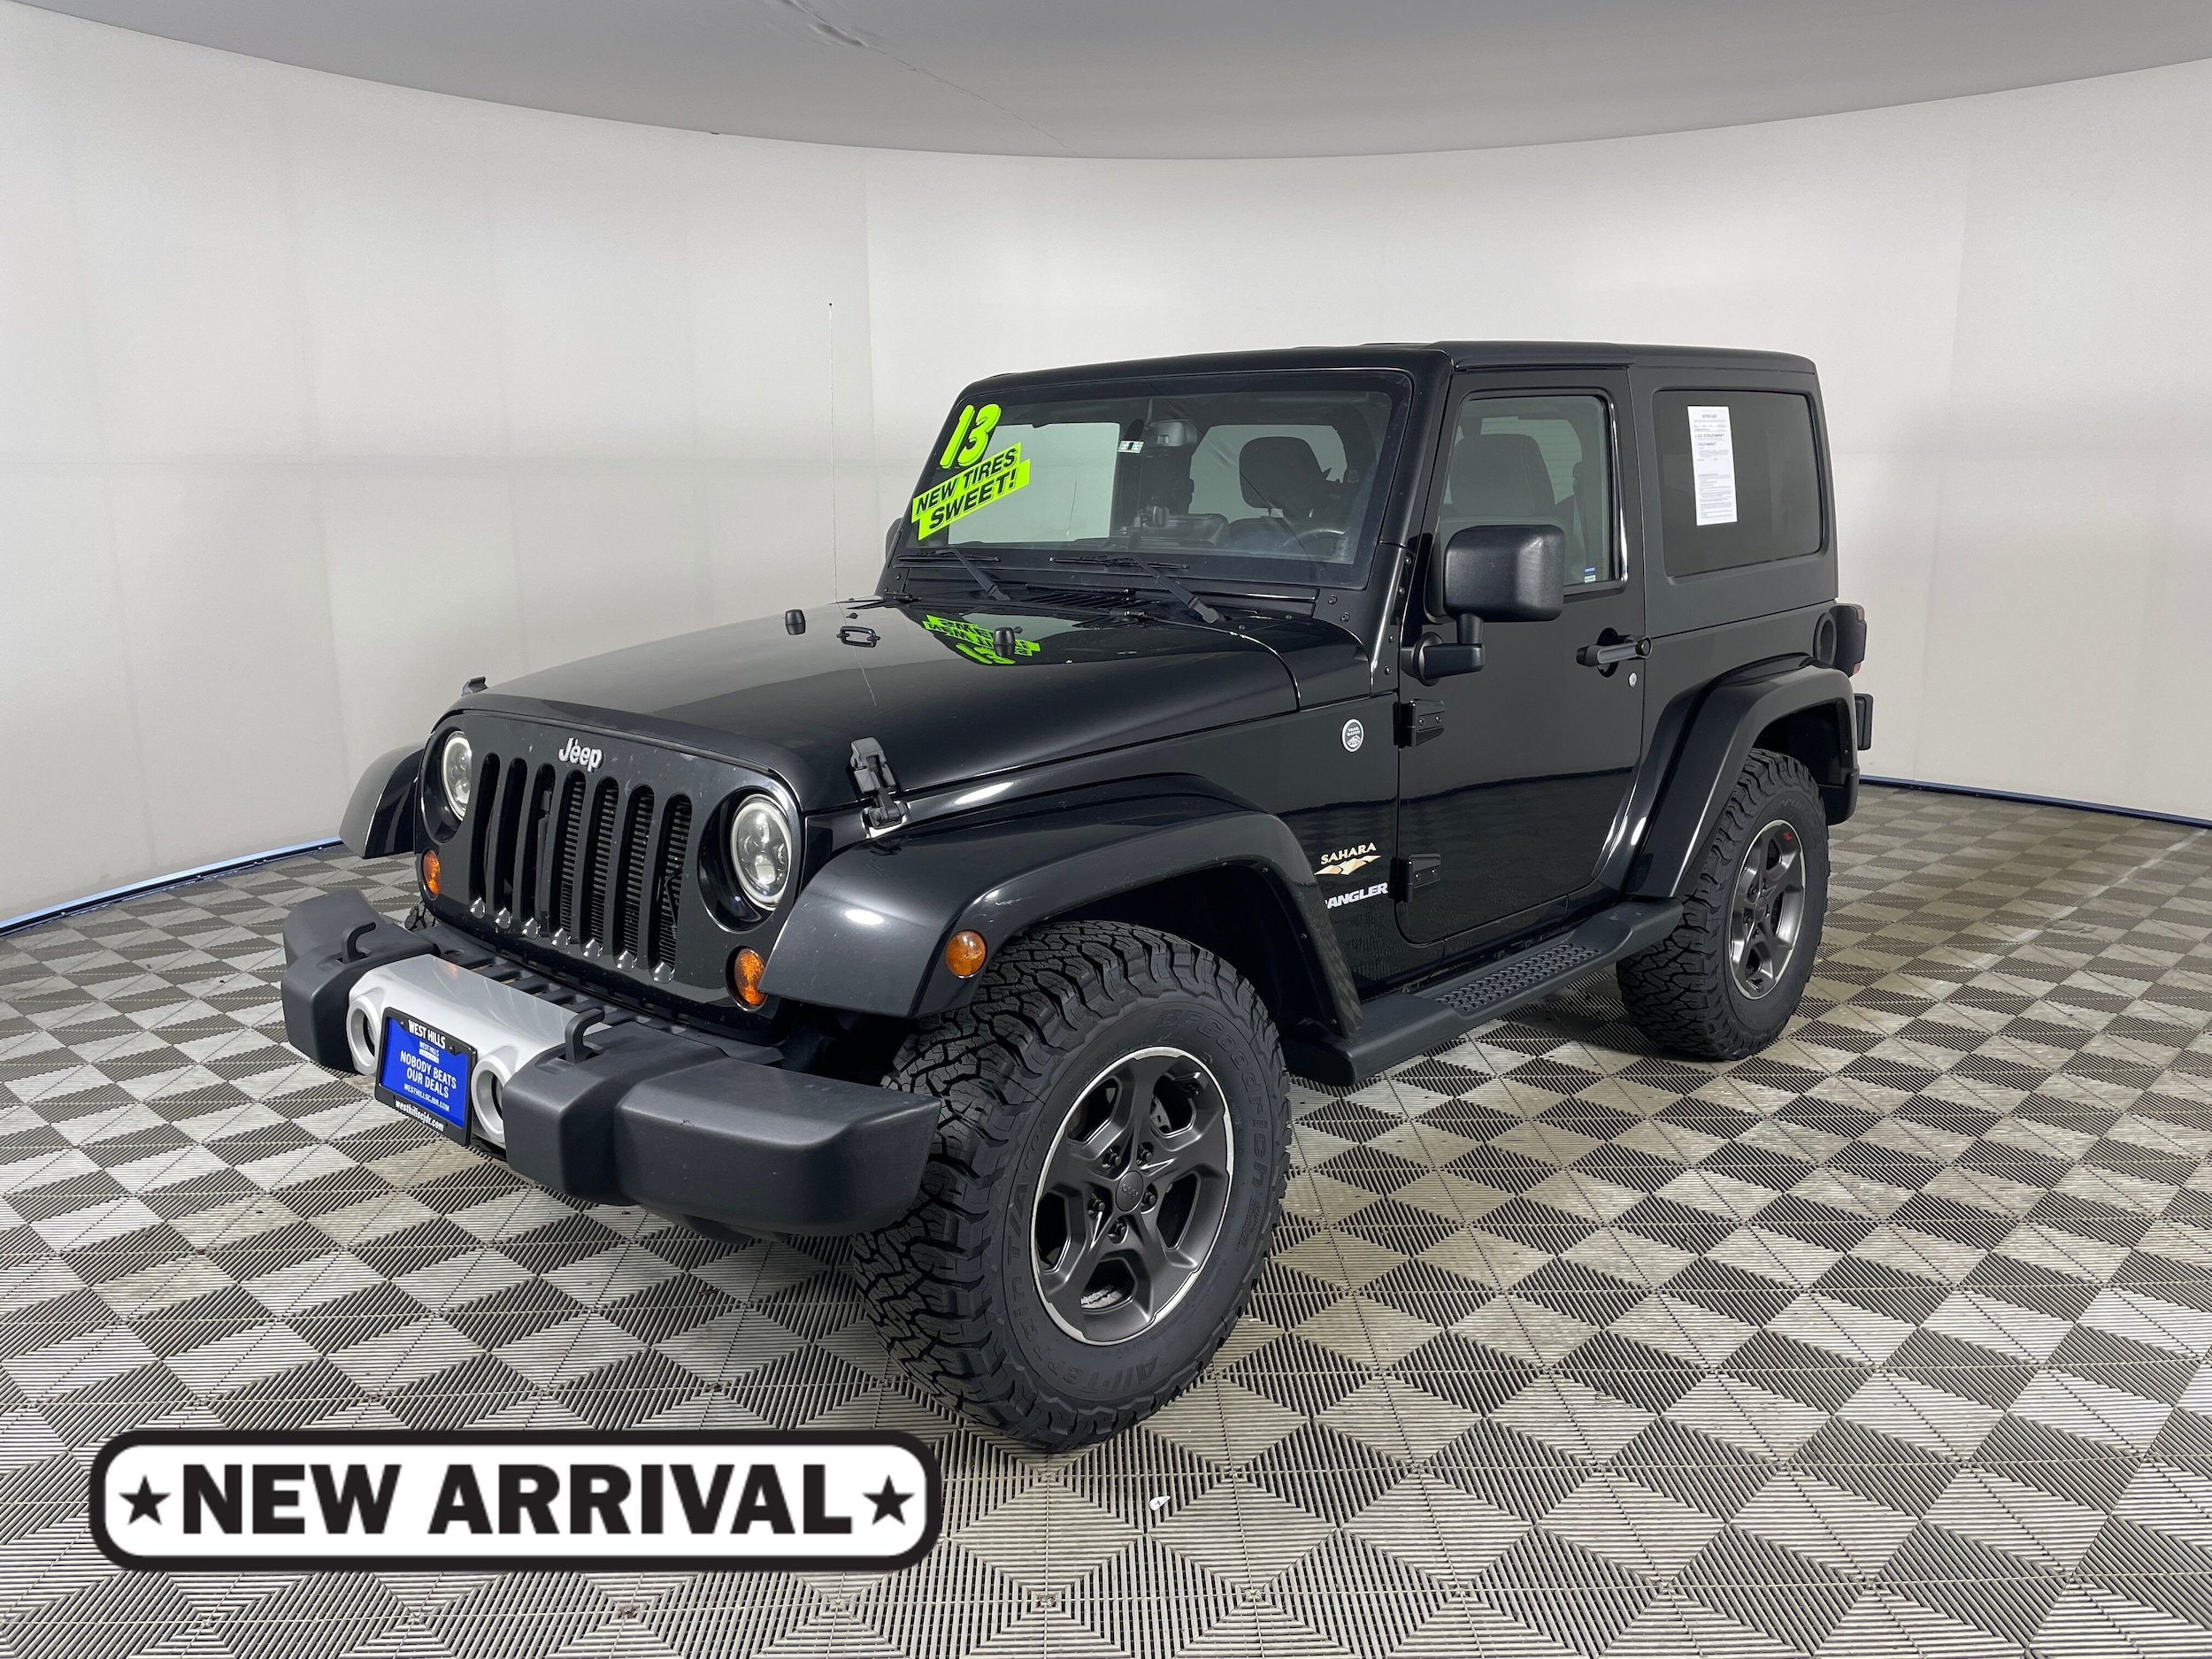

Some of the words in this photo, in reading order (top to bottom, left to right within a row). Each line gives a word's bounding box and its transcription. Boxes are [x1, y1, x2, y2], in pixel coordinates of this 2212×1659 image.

[940, 403, 1002, 468] 13
[917, 479, 958, 515] NEW
[964, 448, 1017, 489] TIRES
[929, 469, 1018, 530] SWEET!
[558, 737, 603, 772] Jeep
[1320, 842, 1377, 864] SAHARA
[1325, 882, 1388, 909] ANGLER
[408, 1019, 426, 1038] WEST
[427, 1028, 446, 1050] HILLS
[400, 1049, 431, 1075] NOBODY
[433, 1066, 457, 1089] BEATS
[406, 1066, 423, 1086] OUR
[425, 1076, 449, 1099] DEALS
[396, 1099, 444, 1132] westhillscjdr.com
